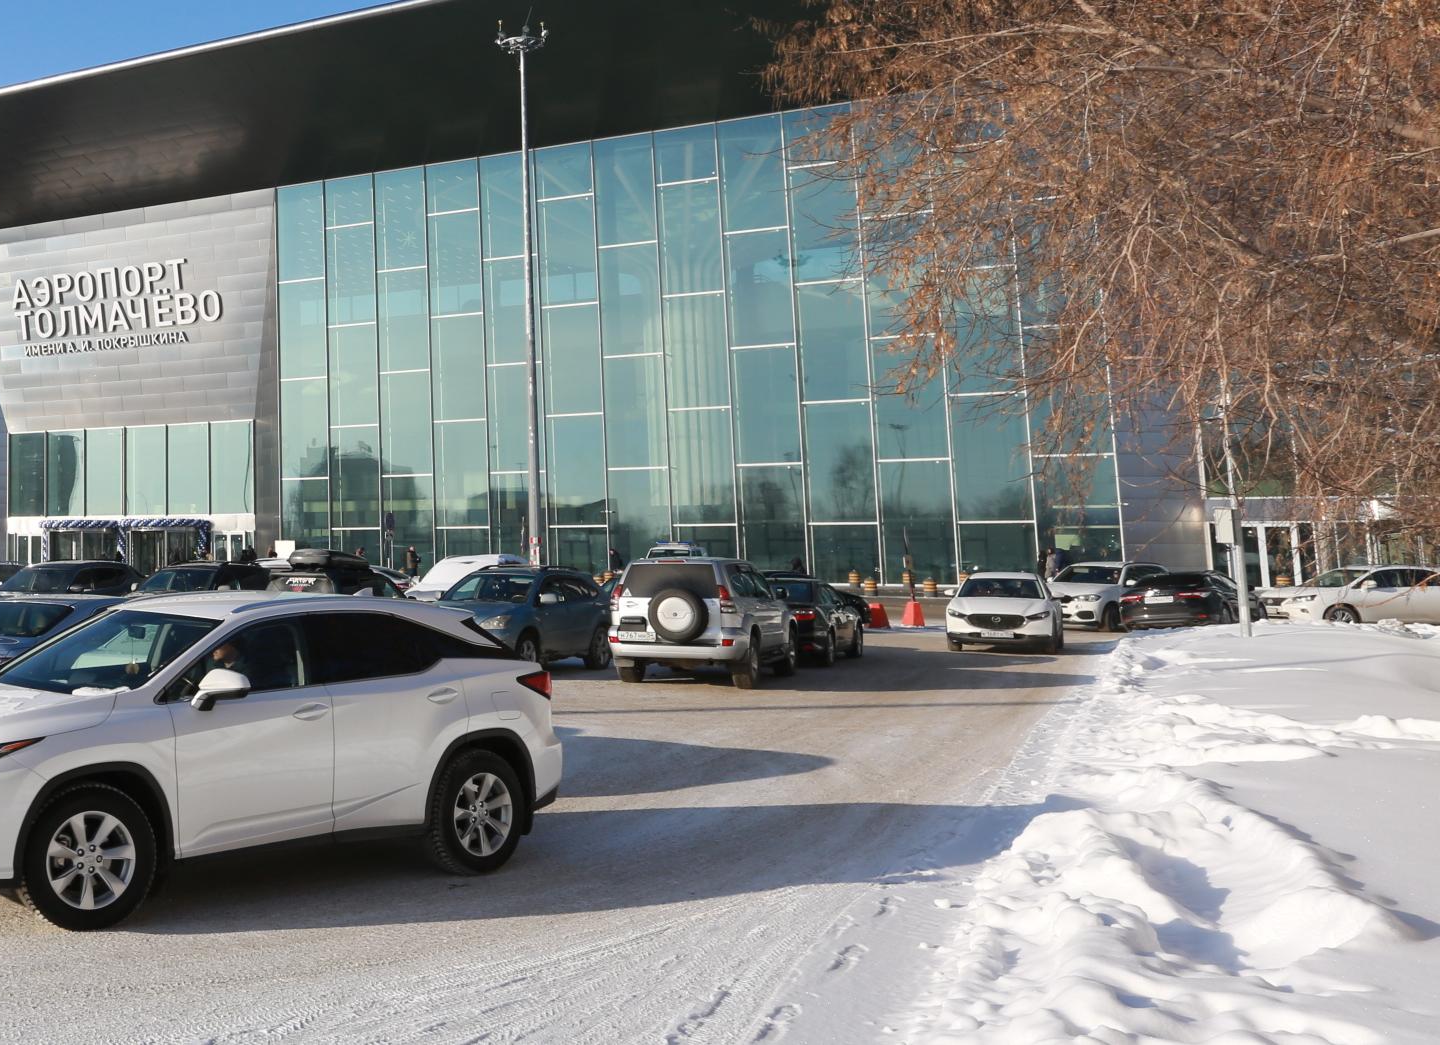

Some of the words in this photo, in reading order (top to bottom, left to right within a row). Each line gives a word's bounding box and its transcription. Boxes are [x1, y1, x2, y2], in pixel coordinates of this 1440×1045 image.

[12, 258, 187, 310] АЭРОПОРТ
[14, 288, 222, 341] ТОЛМАЧЁВО
[24, 342, 63, 357] ИМЕНИ
[97, 331, 189, 350] ПОКРЫШКИНА
